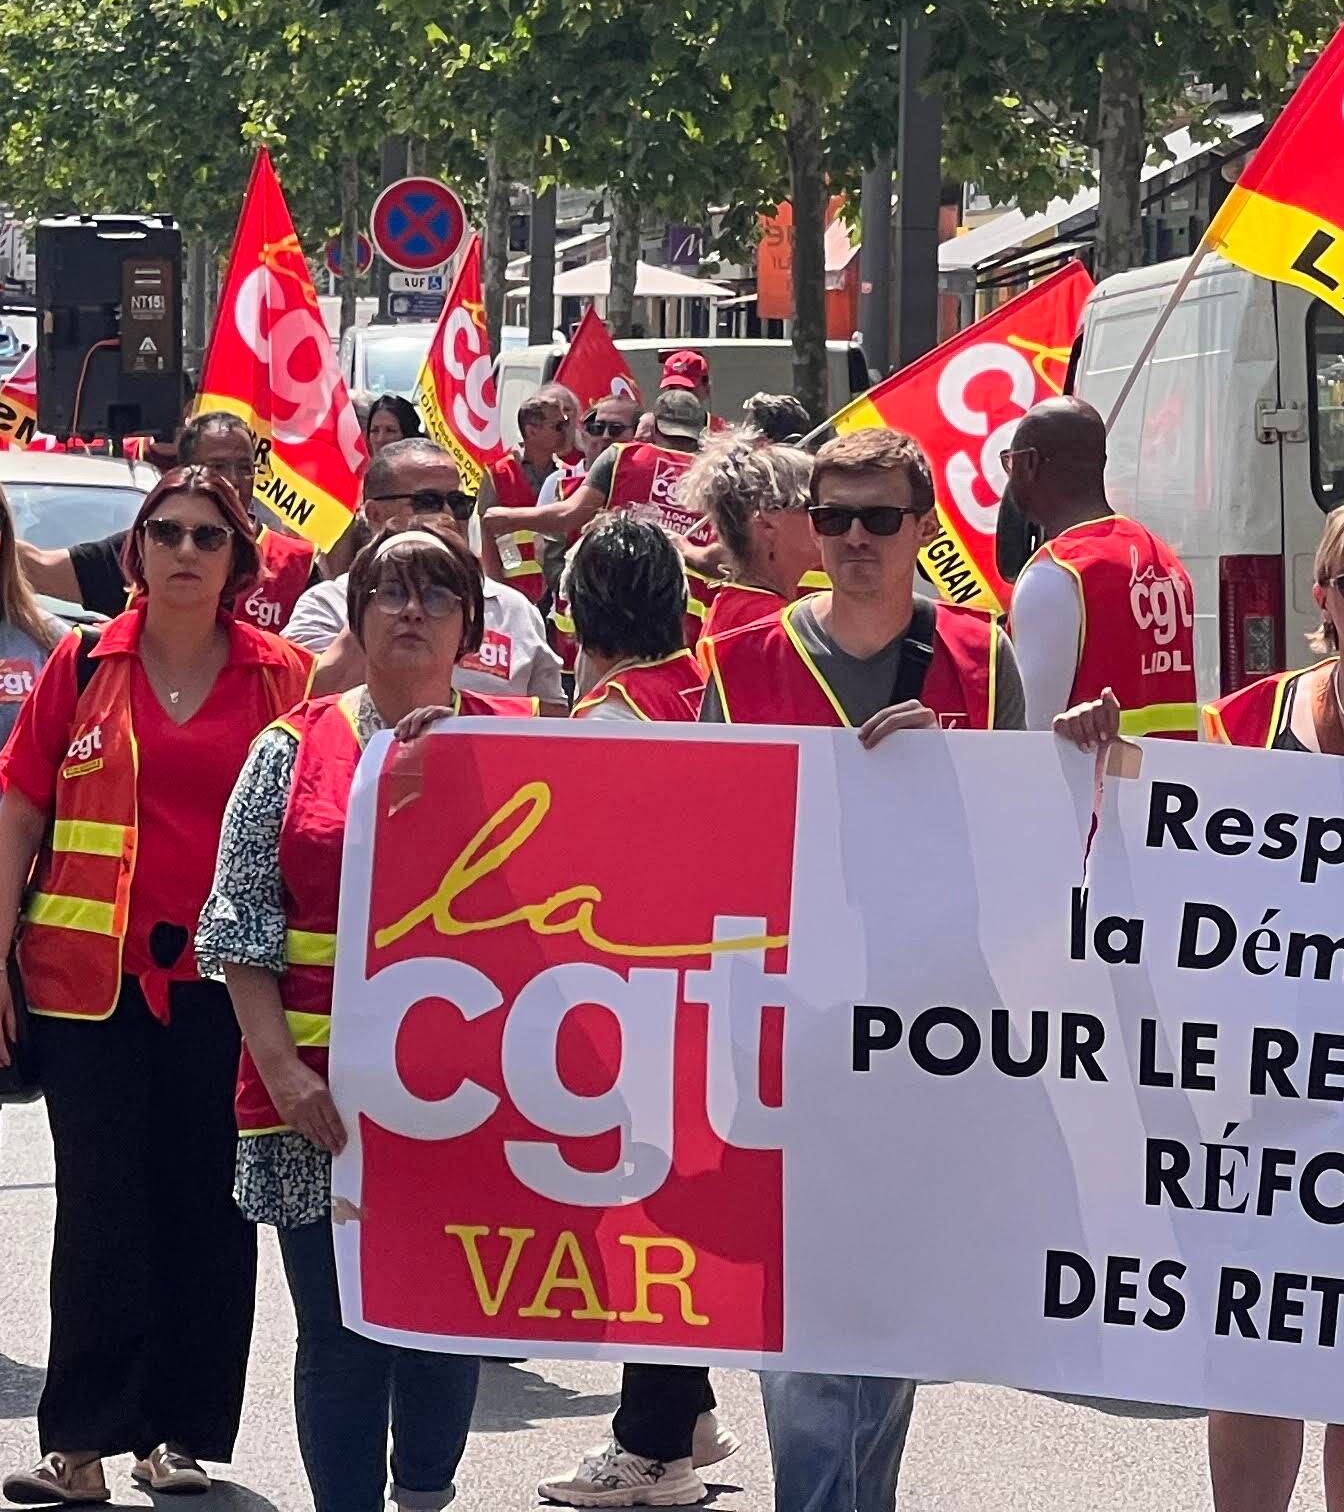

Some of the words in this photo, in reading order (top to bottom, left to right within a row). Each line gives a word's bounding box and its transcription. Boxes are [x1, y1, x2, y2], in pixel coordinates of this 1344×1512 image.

[404, 277, 426, 288] AUF
[245, 594, 282, 626] cgt
[1131, 567, 1193, 645] cgt
[479, 641, 508, 667] gt
[1141, 651, 1192, 675] LIDL
[67, 725, 103, 760] cgt
[374, 782, 789, 957] la
[1070, 885, 1144, 965] la
[354, 915, 786, 1207] cgt
[852, 1005, 1109, 1082] POUR
[1140, 1018, 1218, 1092] LE
[445, 1224, 709, 1326] VAR
[1043, 1249, 1187, 1332] DES
